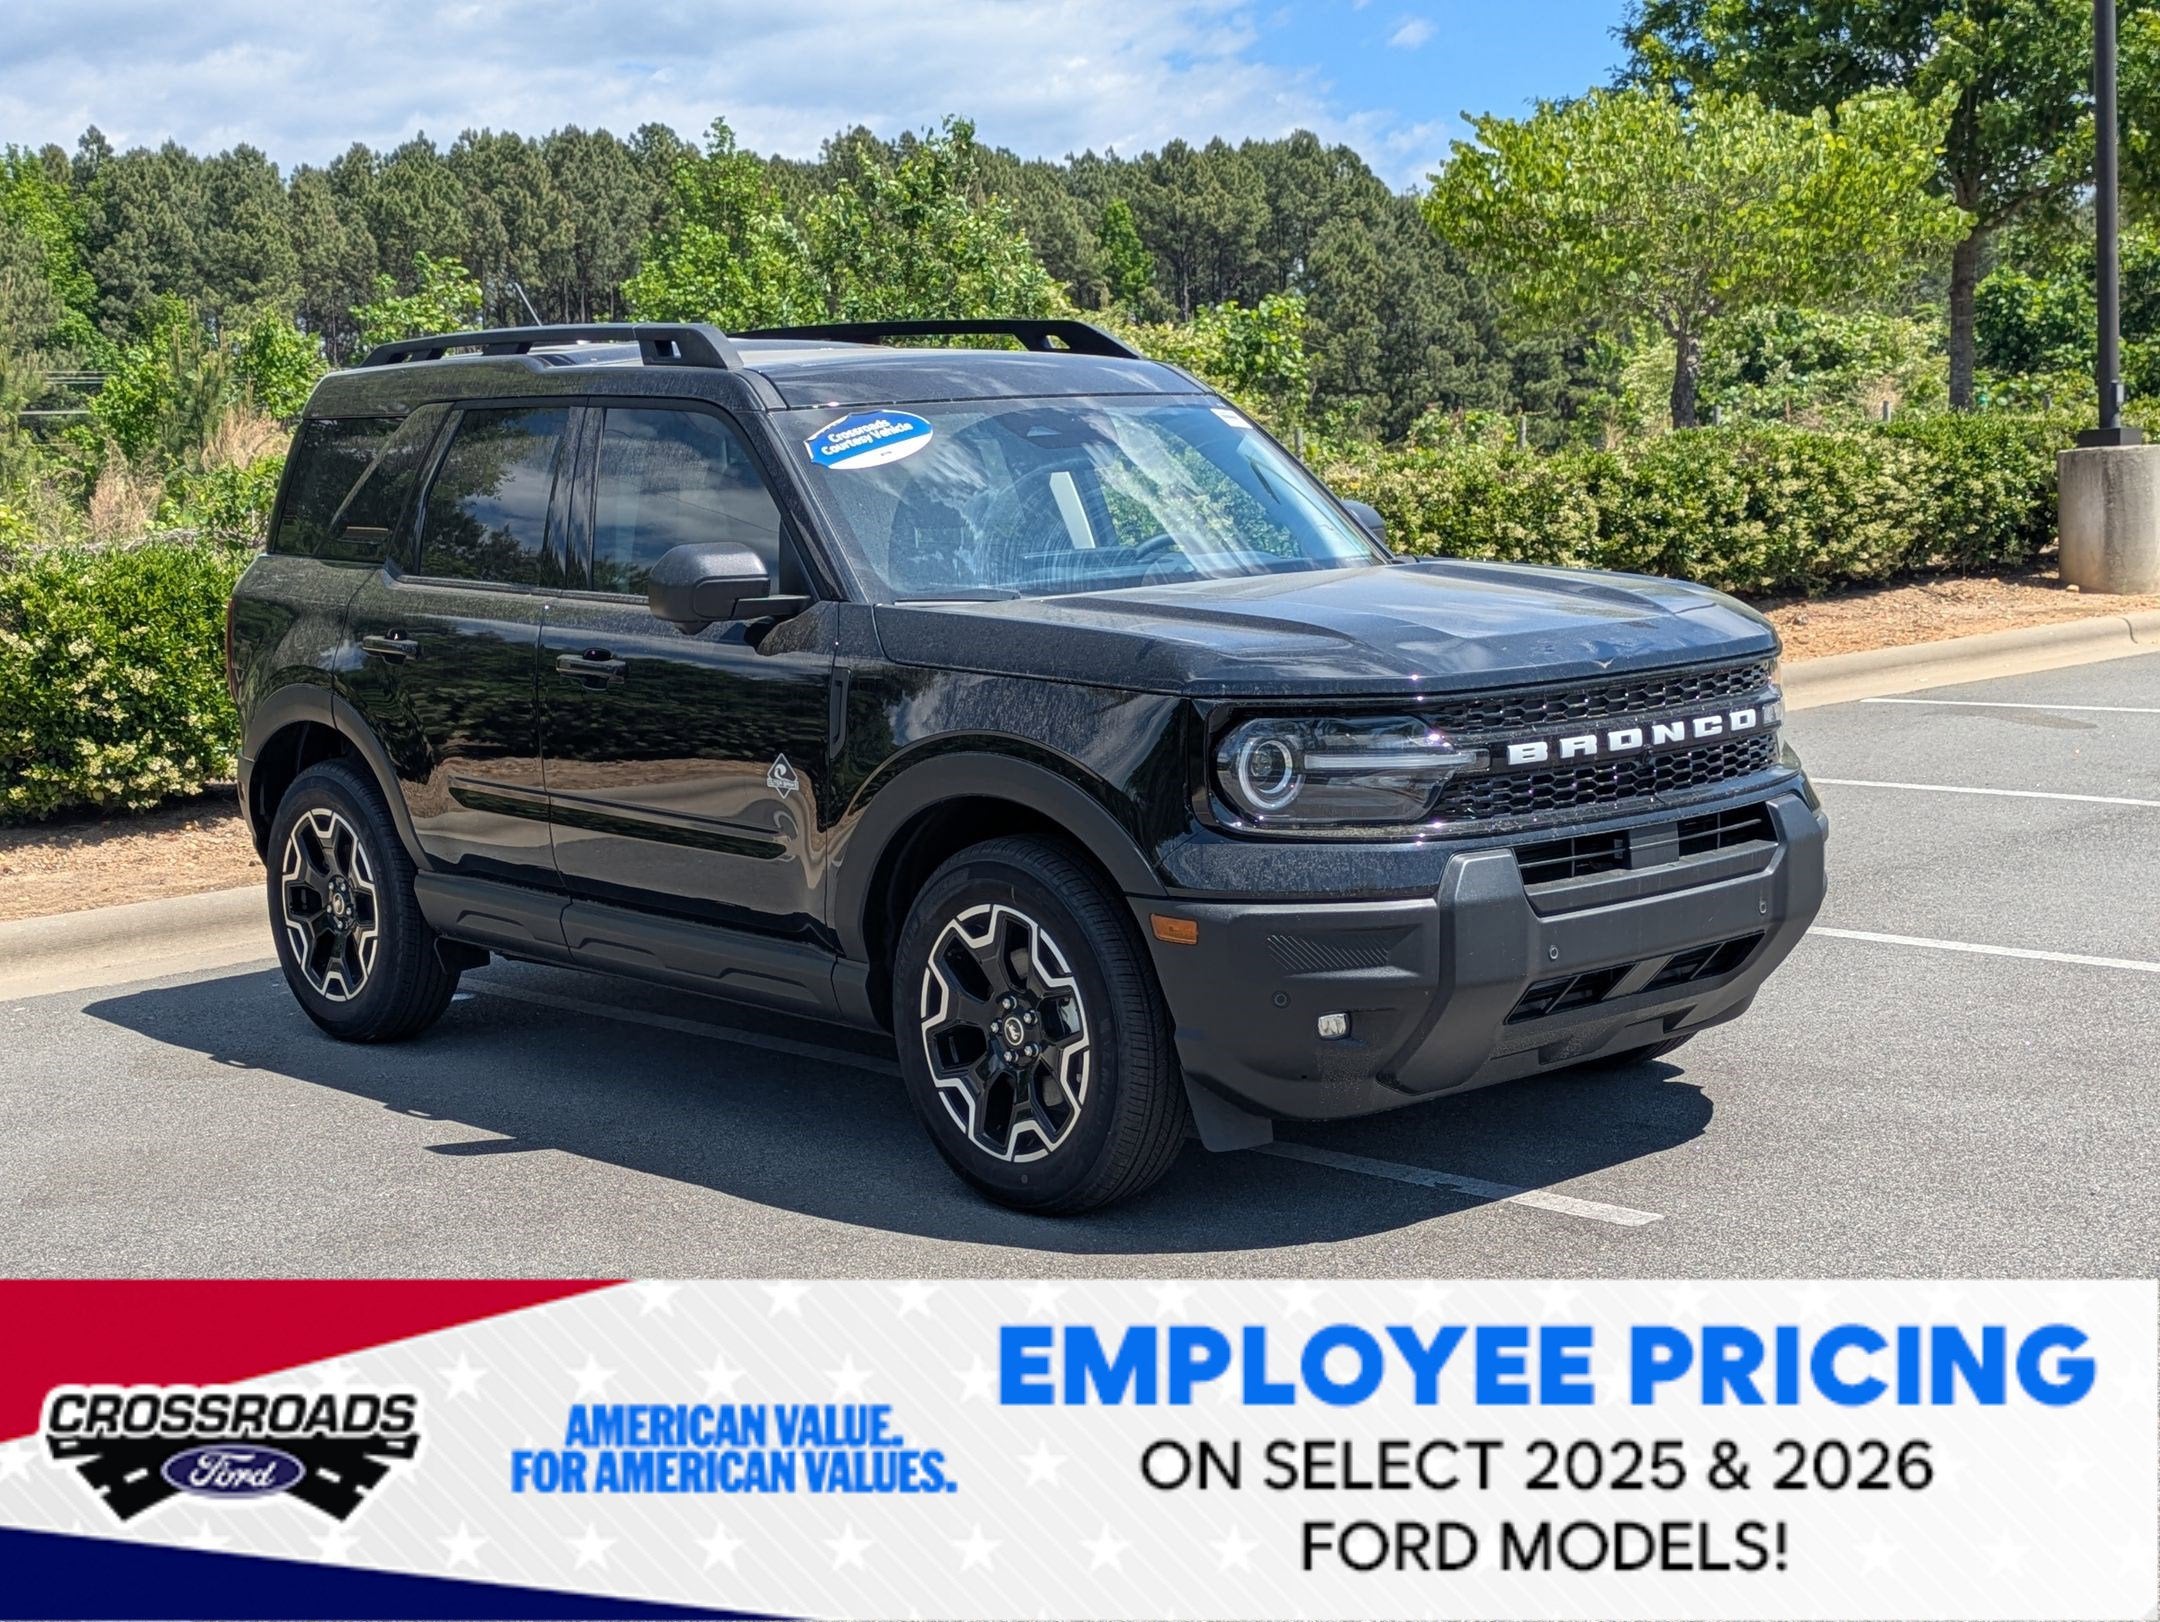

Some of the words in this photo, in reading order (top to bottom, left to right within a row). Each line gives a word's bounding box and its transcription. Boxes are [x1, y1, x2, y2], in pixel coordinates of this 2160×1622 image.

[821, 432, 874, 456] Courtesy
[872, 422, 914, 440] Vehicle
[828, 419, 891, 443] Crossroads
[1507, 708, 1756, 765] BRONCO
